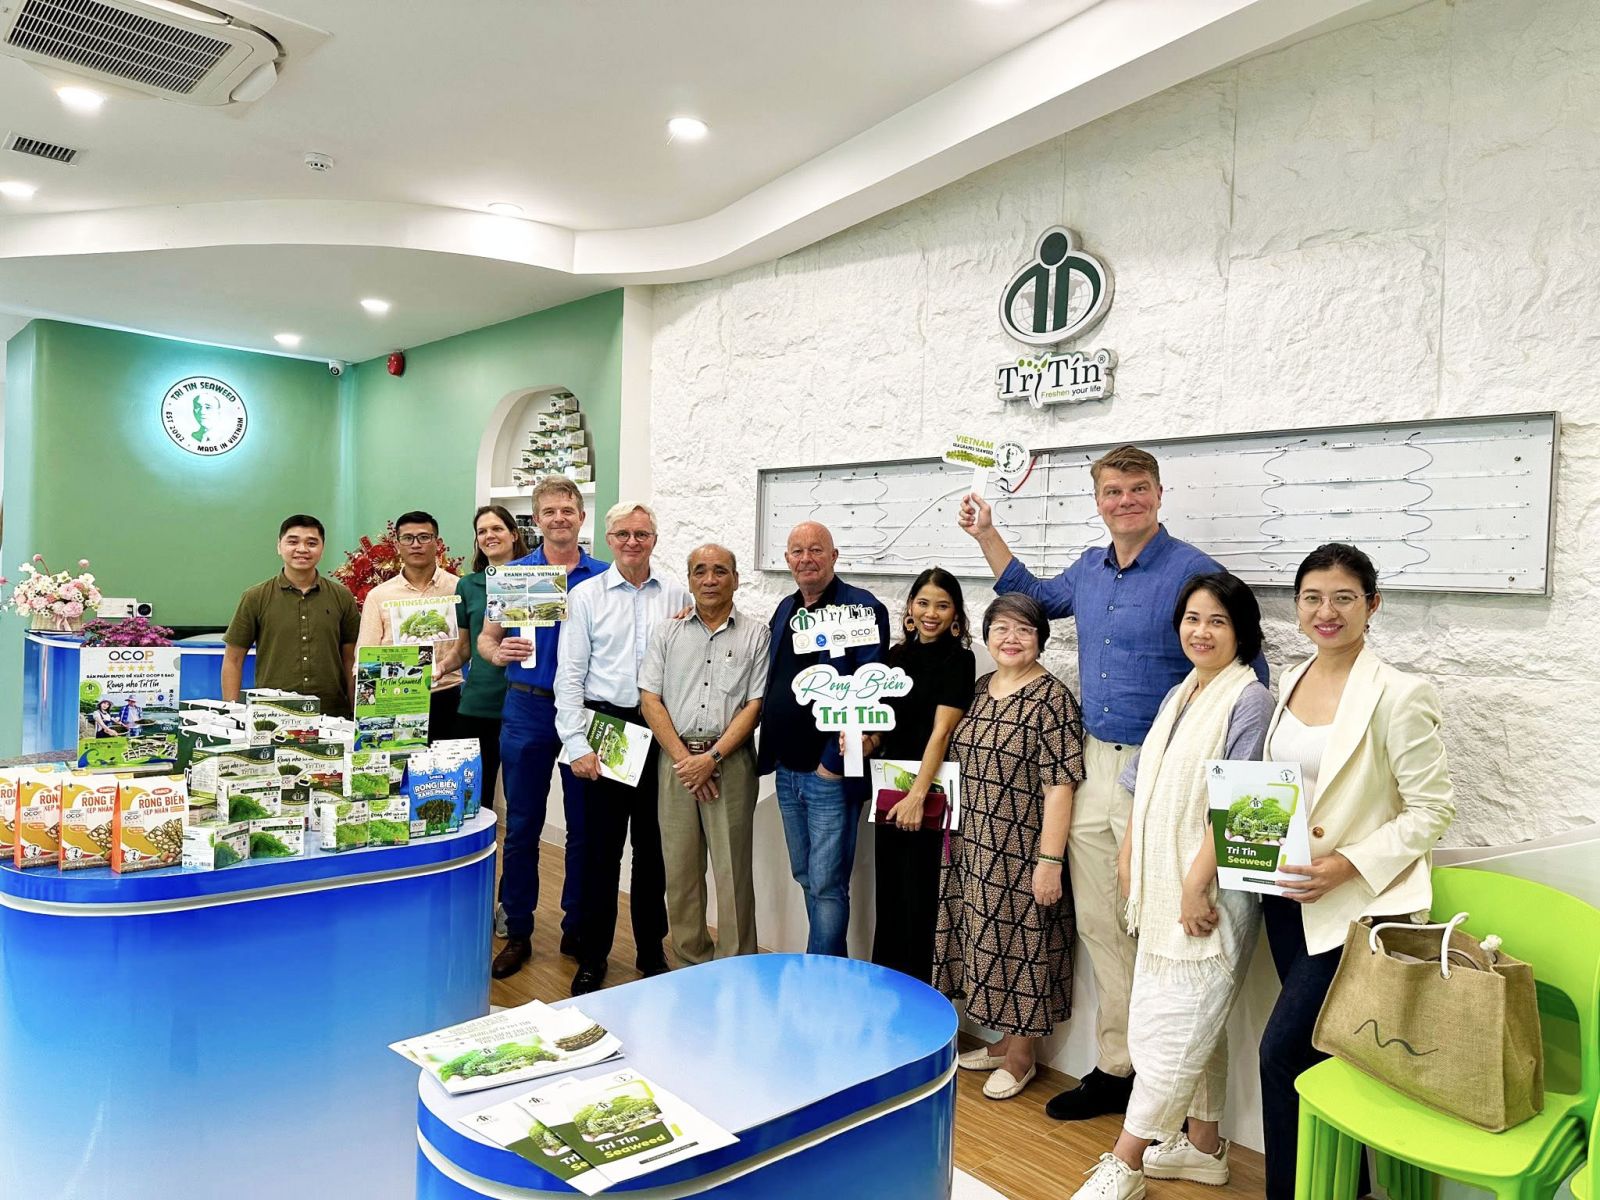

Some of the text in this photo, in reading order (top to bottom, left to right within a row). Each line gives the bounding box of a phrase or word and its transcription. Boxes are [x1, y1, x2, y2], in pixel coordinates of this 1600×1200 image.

[171, 382, 236, 402] TRI TIN SEAWEED
[1041, 385, 1101, 398] Freshen your life
[166, 411, 185, 442] EST 2002
[228, 417, 243, 444] VIETNAM
[956, 434, 994, 449] VIETNAM
[975, 447, 994, 455] SEAWEED
[851, 628, 875, 636] OCOP
[109, 650, 154, 661] OCOP
[107, 680, 124, 691] Rong
[126, 680, 137, 688] nho
[398, 675, 422, 686] Seaweed
[798, 669, 905, 700] Rong Biển
[819, 706, 888, 724] Trí Tín
[415, 782, 437, 793] RONG
[440, 778, 457, 789] BIỂN
[40, 794, 60, 804] RON
[82, 796, 106, 807] RONG
[139, 790, 185, 808] RONG BIỂN
[1226, 846, 1257, 857] Tri Tin
[1228, 856, 1272, 868] Seaweed
[595, 1135, 639, 1152] Tri Tin
[604, 1134, 667, 1159] Seaweed
[560, 1154, 581, 1165] Tri
